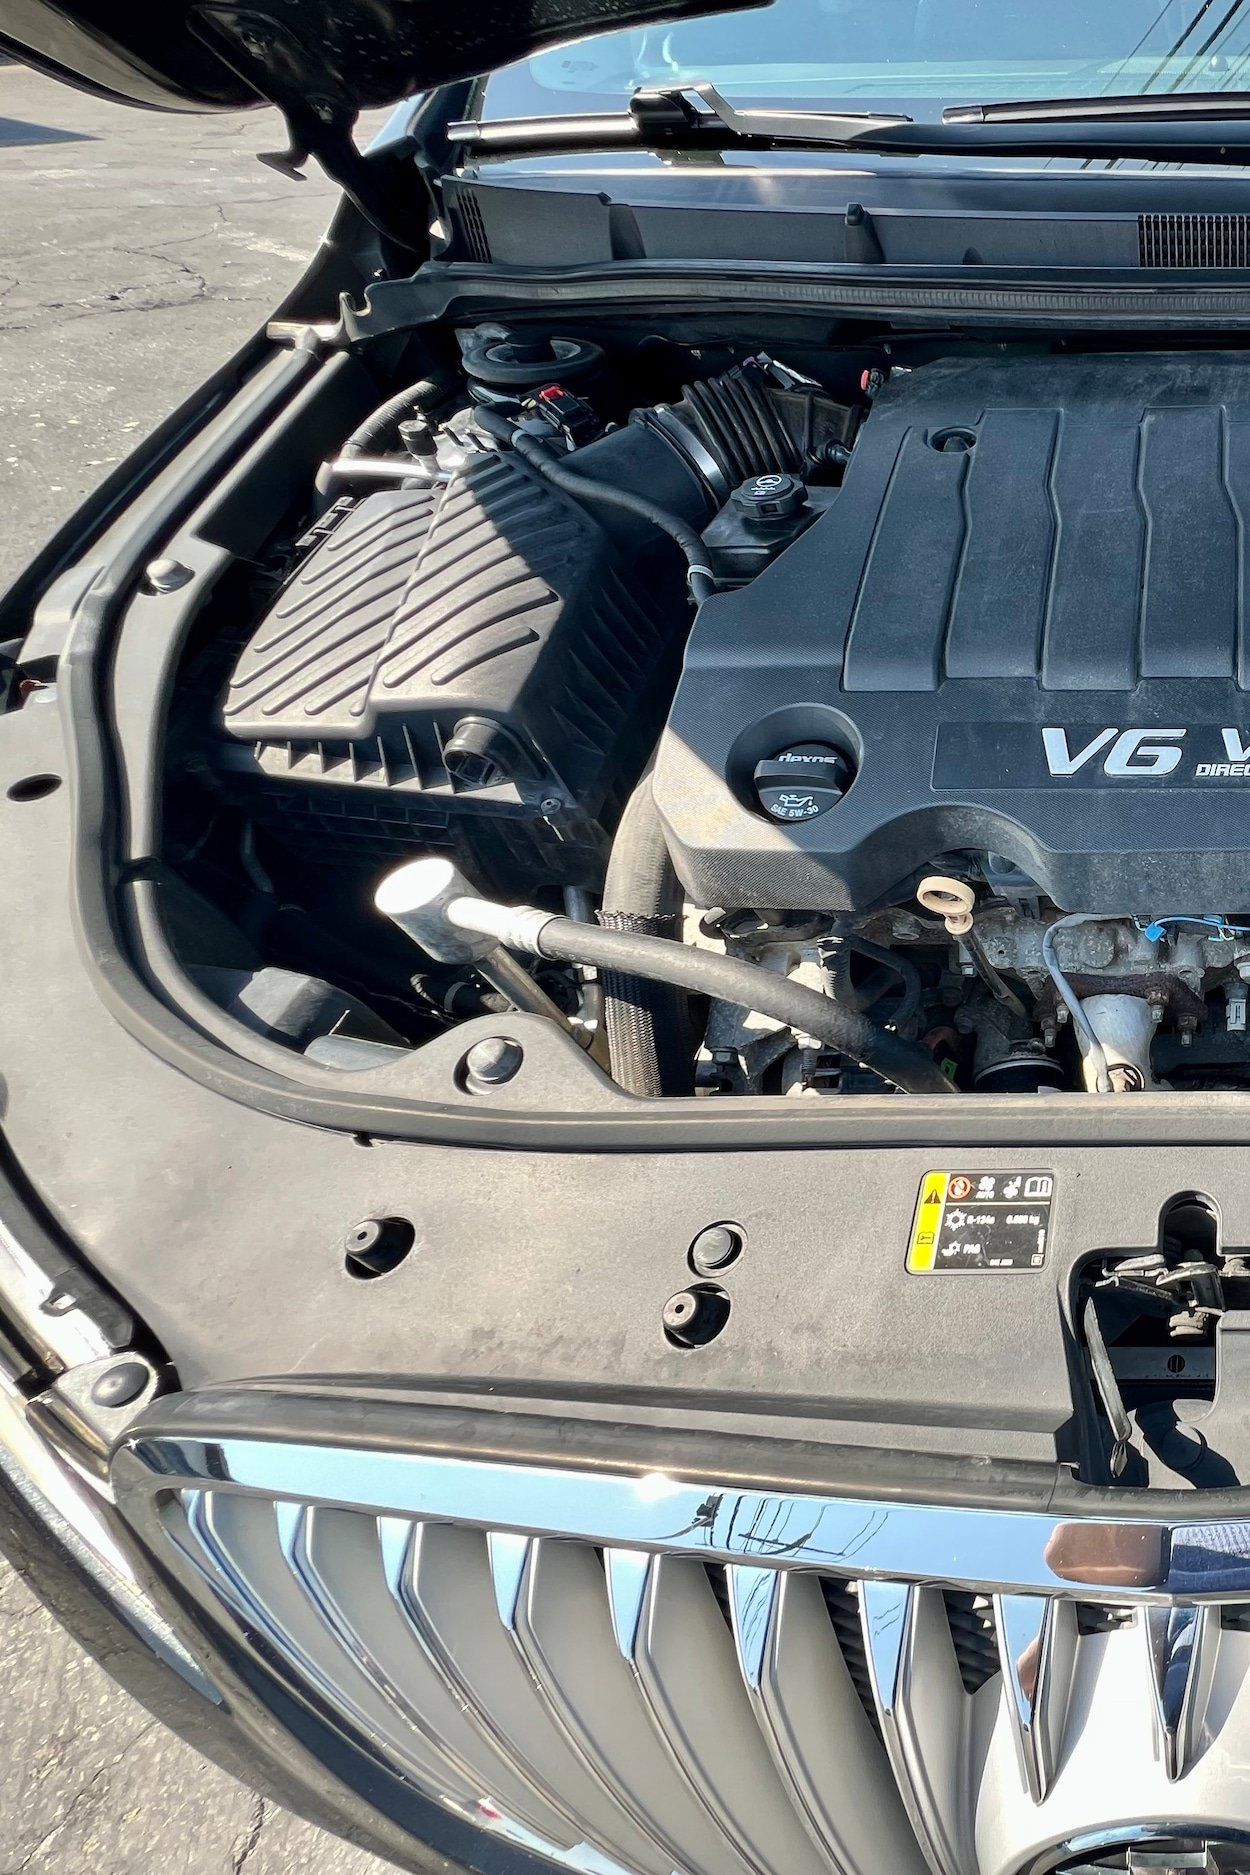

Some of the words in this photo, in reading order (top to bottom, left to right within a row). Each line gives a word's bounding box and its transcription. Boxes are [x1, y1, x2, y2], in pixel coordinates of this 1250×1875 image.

[1041, 727, 1187, 778] V6
[770, 804, 787, 816] SAE
[788, 805, 819, 817] 5W-30
